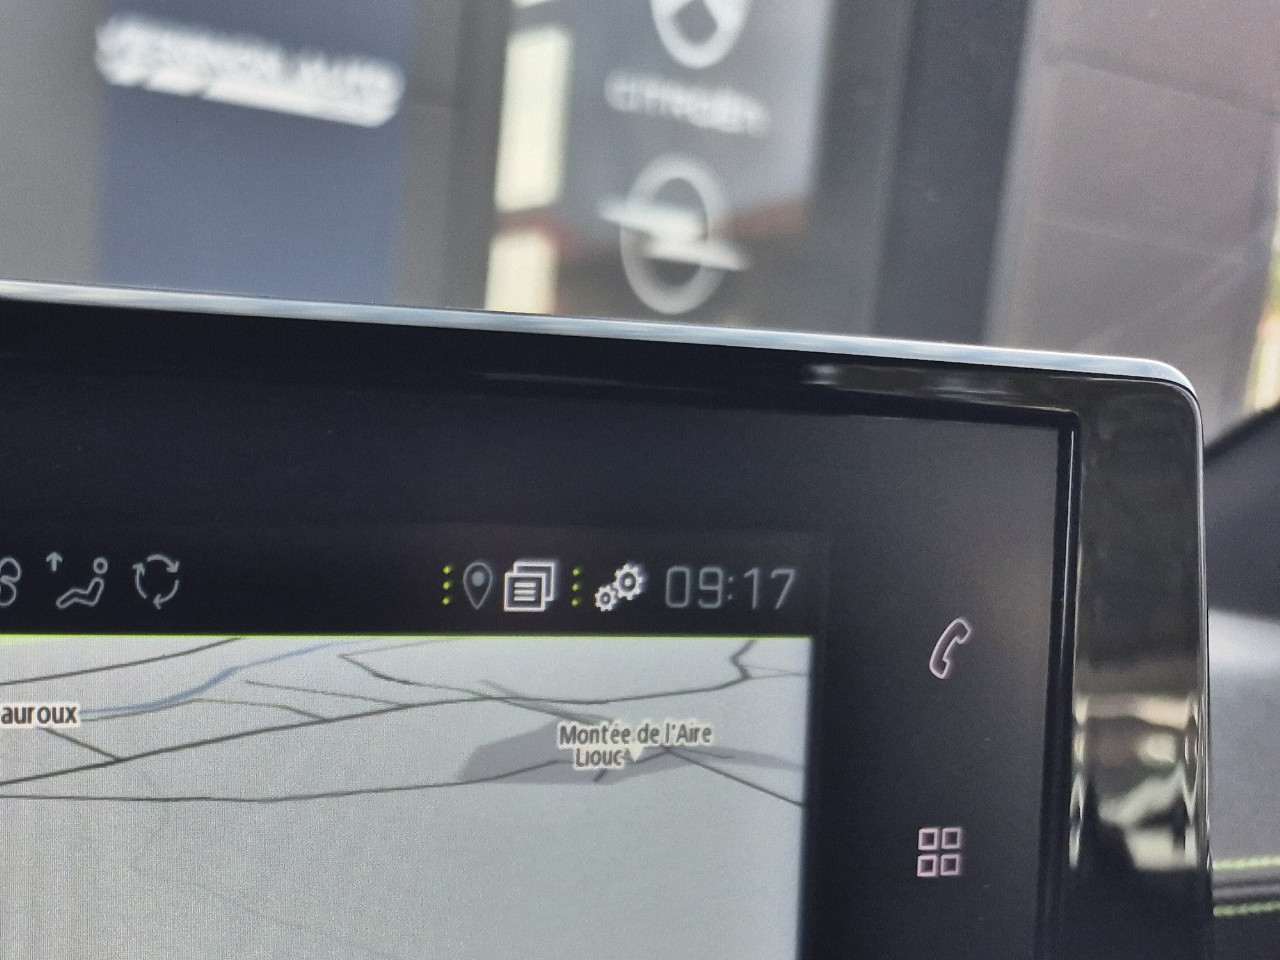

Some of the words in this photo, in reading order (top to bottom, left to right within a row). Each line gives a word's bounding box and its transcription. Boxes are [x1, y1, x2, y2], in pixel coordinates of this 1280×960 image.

[665, 566, 796, 610] 09:17
[559, 722, 631, 745] Montée
[637, 723, 660, 744] de
[665, 722, 712, 743] l'Aire
